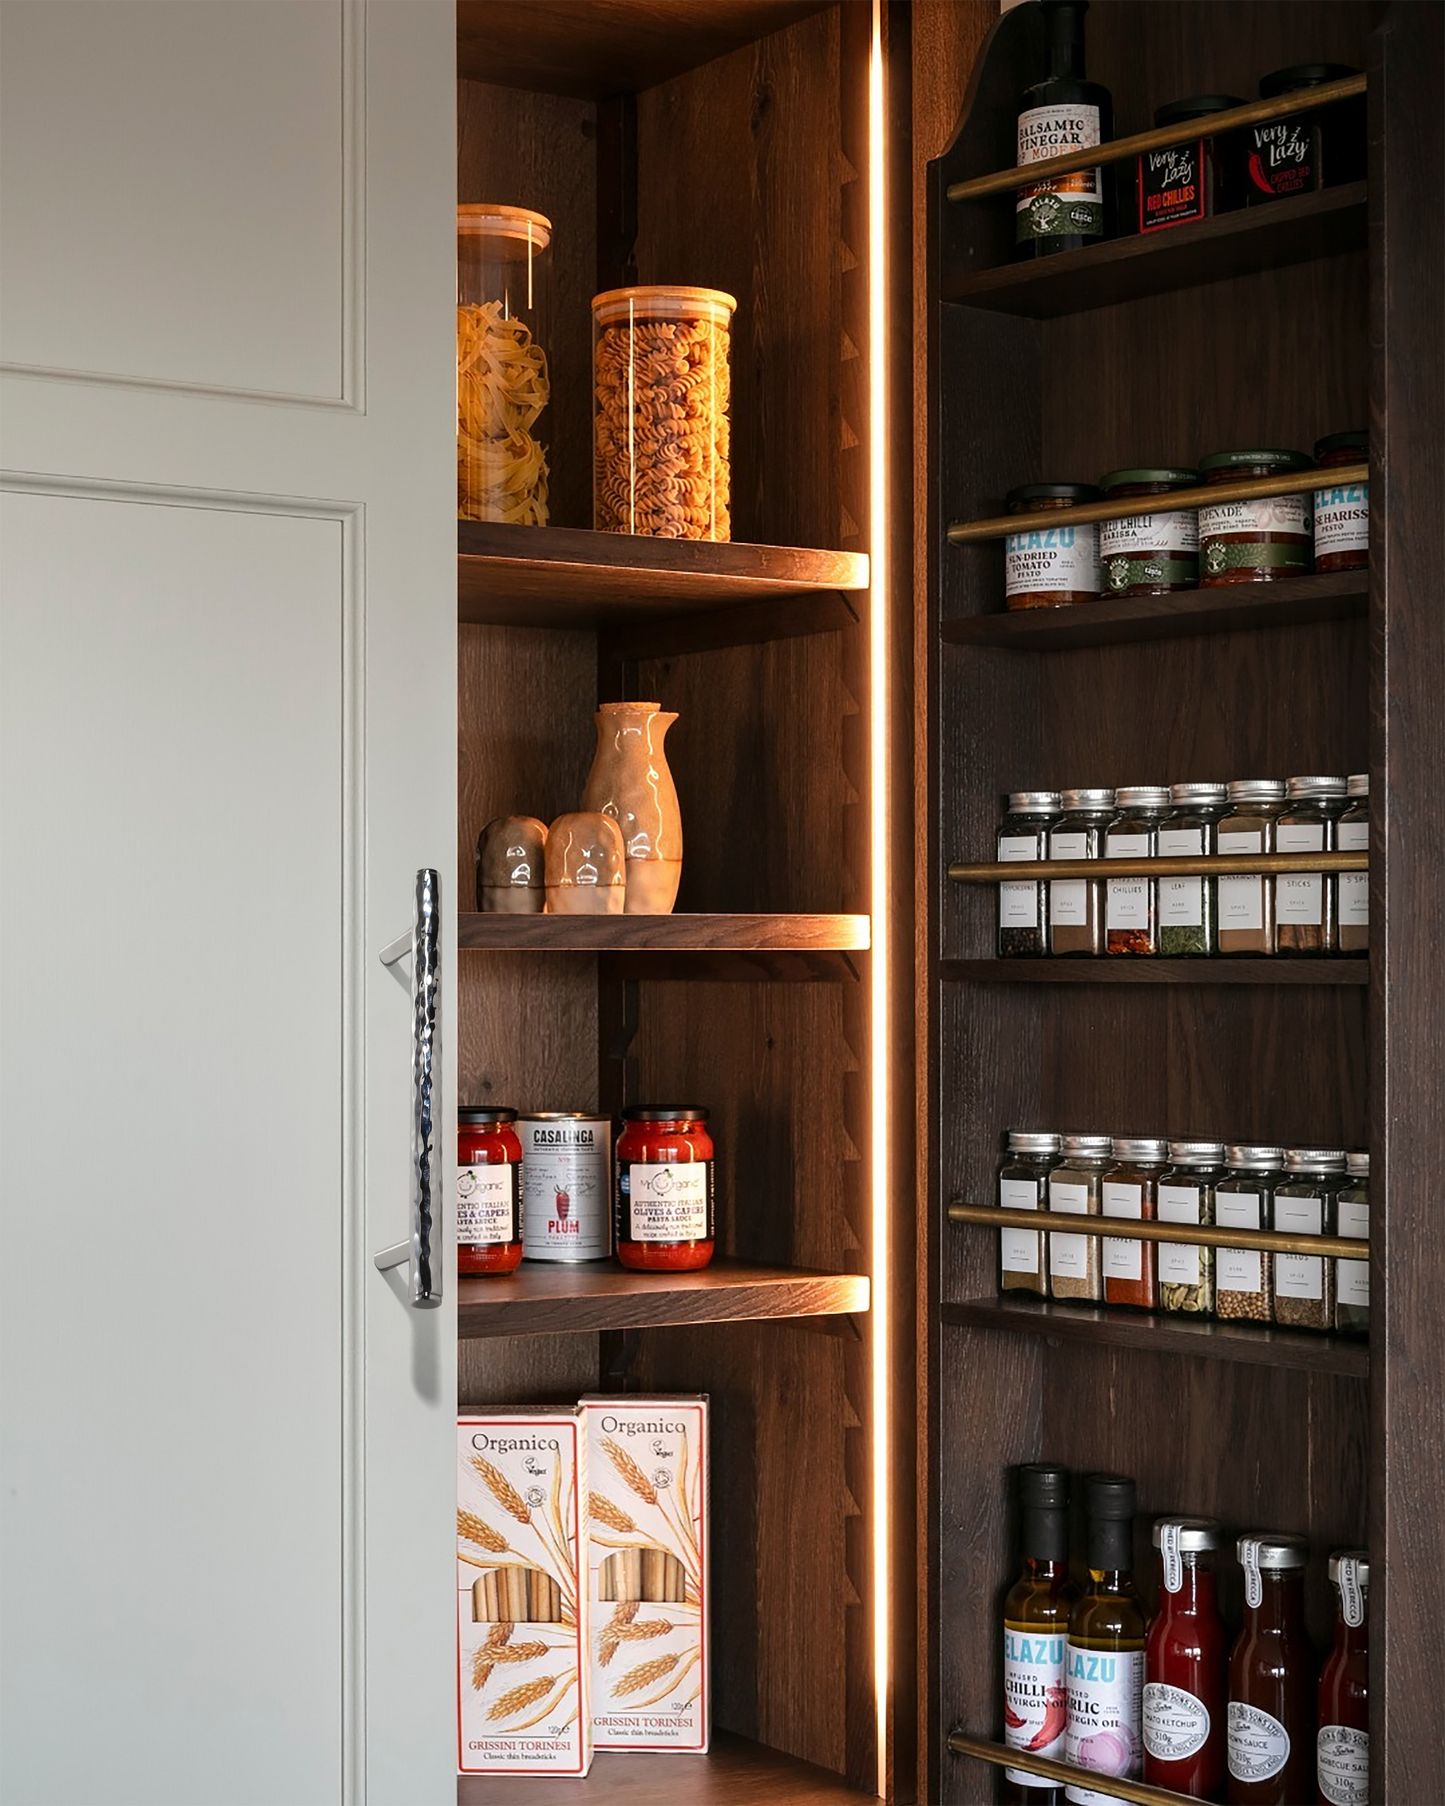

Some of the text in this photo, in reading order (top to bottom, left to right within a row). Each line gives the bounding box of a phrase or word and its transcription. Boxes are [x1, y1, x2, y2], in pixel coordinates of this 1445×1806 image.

[1019, 119, 1084, 140] BALSAMIC
[1019, 133, 1082, 151] VINEGAR
[1253, 125, 1288, 149] Very
[1270, 141, 1309, 167] Lazy
[1148, 150, 1179, 172] Very
[1161, 162, 1192, 188] Lazy
[1147, 194, 1161, 212] RED
[1162, 185, 1195, 207] CHILLIES
[1321, 522, 1344, 533] PESTO
[1011, 560, 1051, 573] TOMATO
[1017, 570, 1042, 579] PESTO
[1286, 880, 1311, 888] STICKS
[1354, 875, 1368, 884] SPI
[1112, 886, 1142, 894] CHILLIES
[533, 1129, 594, 1143] CASALINGA
[457, 1201, 510, 1210] ENTIC ITALIAN
[633, 1198, 704, 1208] AUTHENTIC ITALIAN
[469, 1210, 476, 1218] &
[478, 1208, 510, 1218] CAPERS
[633, 1206, 704, 1216] OLIVES & CAPERS
[548, 1220, 579, 1234] PLUM
[601, 1416, 686, 1437] Organico
[471, 1433, 559, 1455] Organico
[1347, 1587, 1356, 1620] REBECCA
[1008, 1672, 1038, 1683] NFUSED
[1006, 1679, 1046, 1697] CHILLI
[1013, 1697, 1048, 1709] VIRGIN
[593, 1716, 693, 1727] GRISSINI TORINESI
[1101, 1719, 1121, 1729] OIL
[1161, 1718, 1198, 1728] KETCHUP
[1248, 1712, 1267, 1726] SONS
[607, 1728, 679, 1737] Classic thin breadsticks
[468, 1741, 571, 1751] GRISSINI TORINESI
[1230, 1735, 1269, 1750] OWN SAUCE
[1353, 1735, 1369, 1748] SON
[483, 1752, 505, 1760] Classic
[506, 1752, 520, 1760] thin
[1334, 1776, 1355, 1791] 310g
